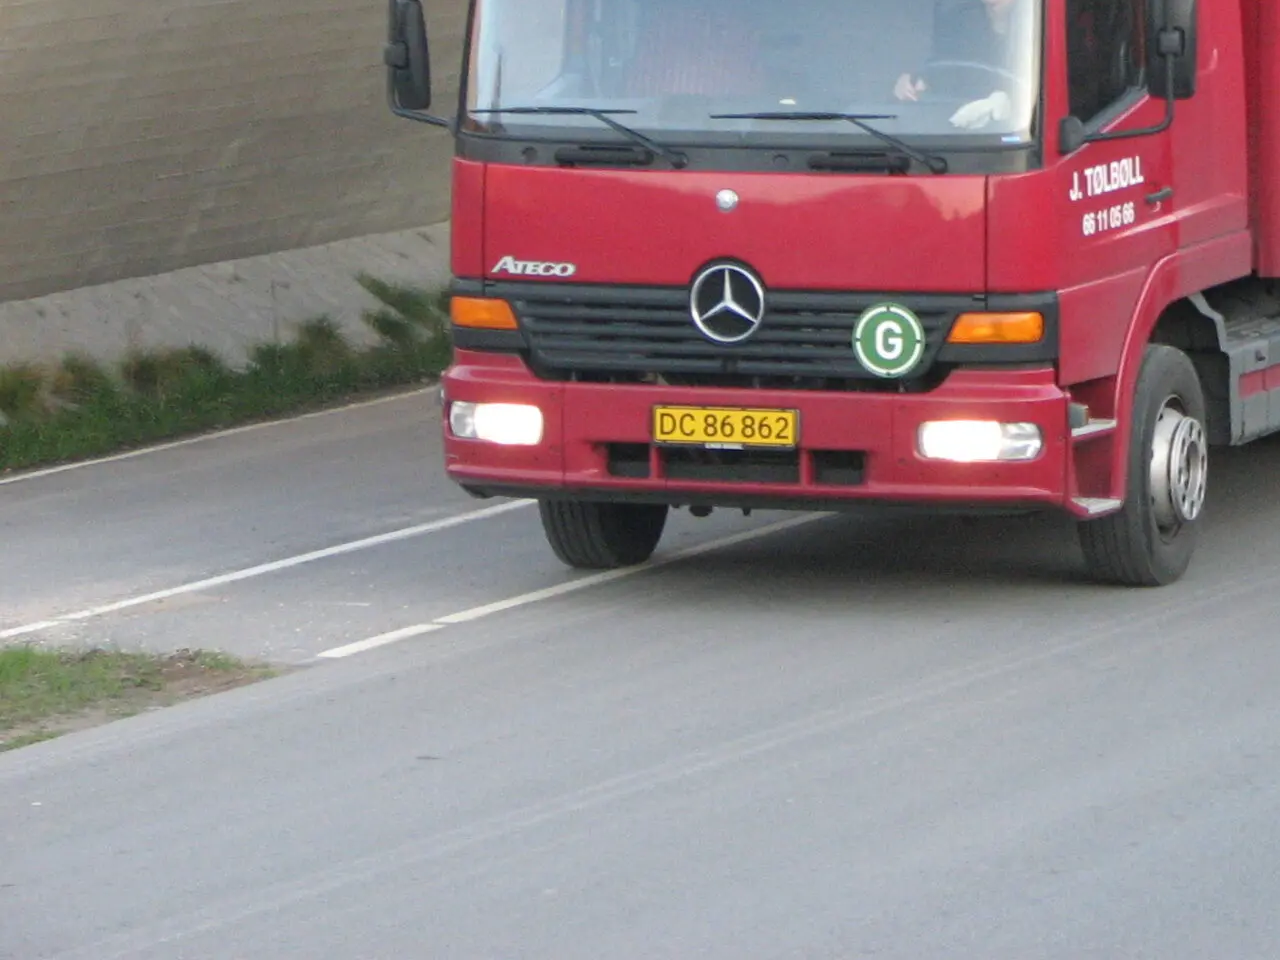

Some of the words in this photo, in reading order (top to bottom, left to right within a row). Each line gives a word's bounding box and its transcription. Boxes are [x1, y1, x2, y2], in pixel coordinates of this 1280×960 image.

[1069, 171, 1083, 201] J.
[1084, 155, 1144, 196] TØLBØLL
[1082, 212, 1096, 236] 66
[1097, 209, 1108, 232] 11
[1109, 204, 1121, 228] 05
[1122, 201, 1135, 225] 66
[875, 320, 903, 360] G
[660, 413, 696, 436] DC
[703, 414, 735, 438] 86
[741, 415, 789, 440] 862
